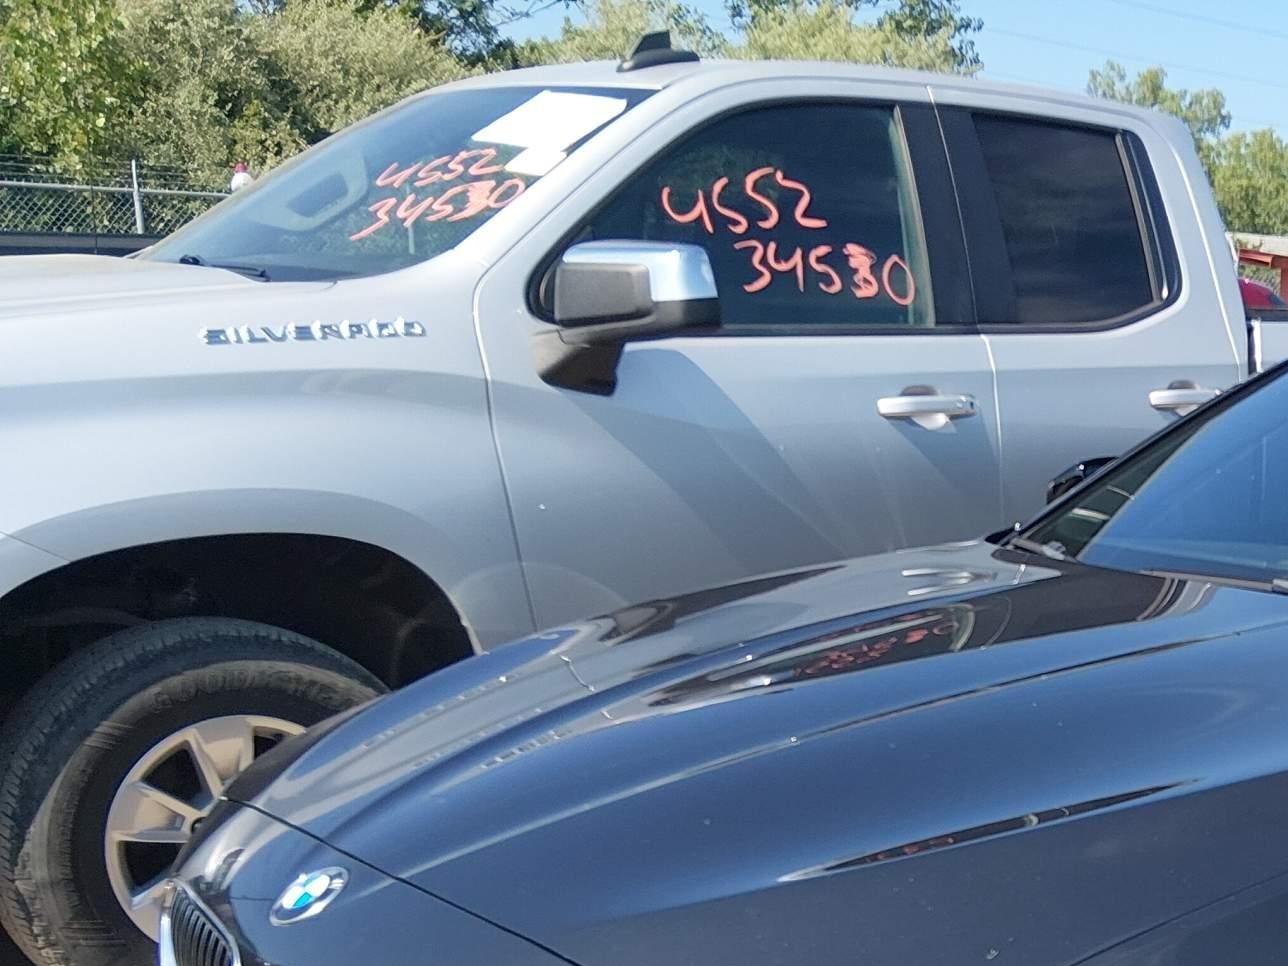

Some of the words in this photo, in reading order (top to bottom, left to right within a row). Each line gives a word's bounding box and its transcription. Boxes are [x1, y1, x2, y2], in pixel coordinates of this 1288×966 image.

[375, 148, 504, 188] 4552
[660, 166, 828, 234] 4552
[200, 316, 428, 346] SILVERADO
